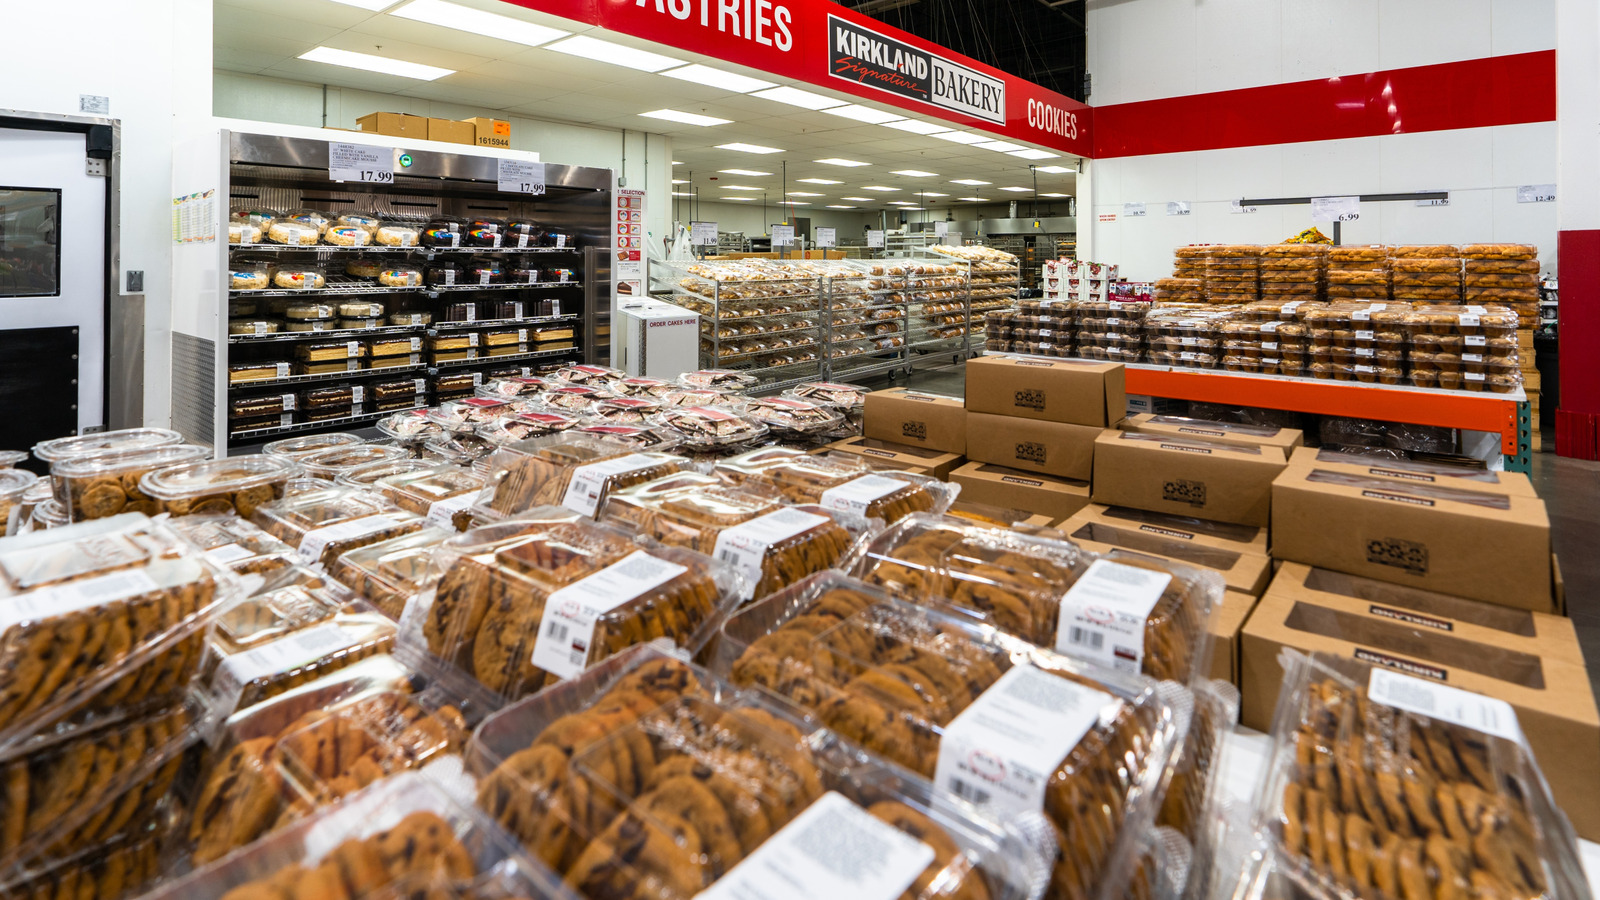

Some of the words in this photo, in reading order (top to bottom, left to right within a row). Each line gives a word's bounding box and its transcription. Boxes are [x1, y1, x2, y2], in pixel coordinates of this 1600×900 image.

[837, 27, 928, 80] KIRKLAND
[836, 56, 927, 93] Signature
[934, 65, 1002, 114] BAKERY
[1028, 98, 1077, 140] COOKIES
[479, 137, 509, 146] 1615944
[360, 170, 392, 182] 17.99
[520, 183, 544, 193] 17.99
[1338, 213, 1360, 221] 6.99
[1372, 608, 1449, 630] KIRKLAND
[1357, 652, 1443, 679] KIRKLAND
